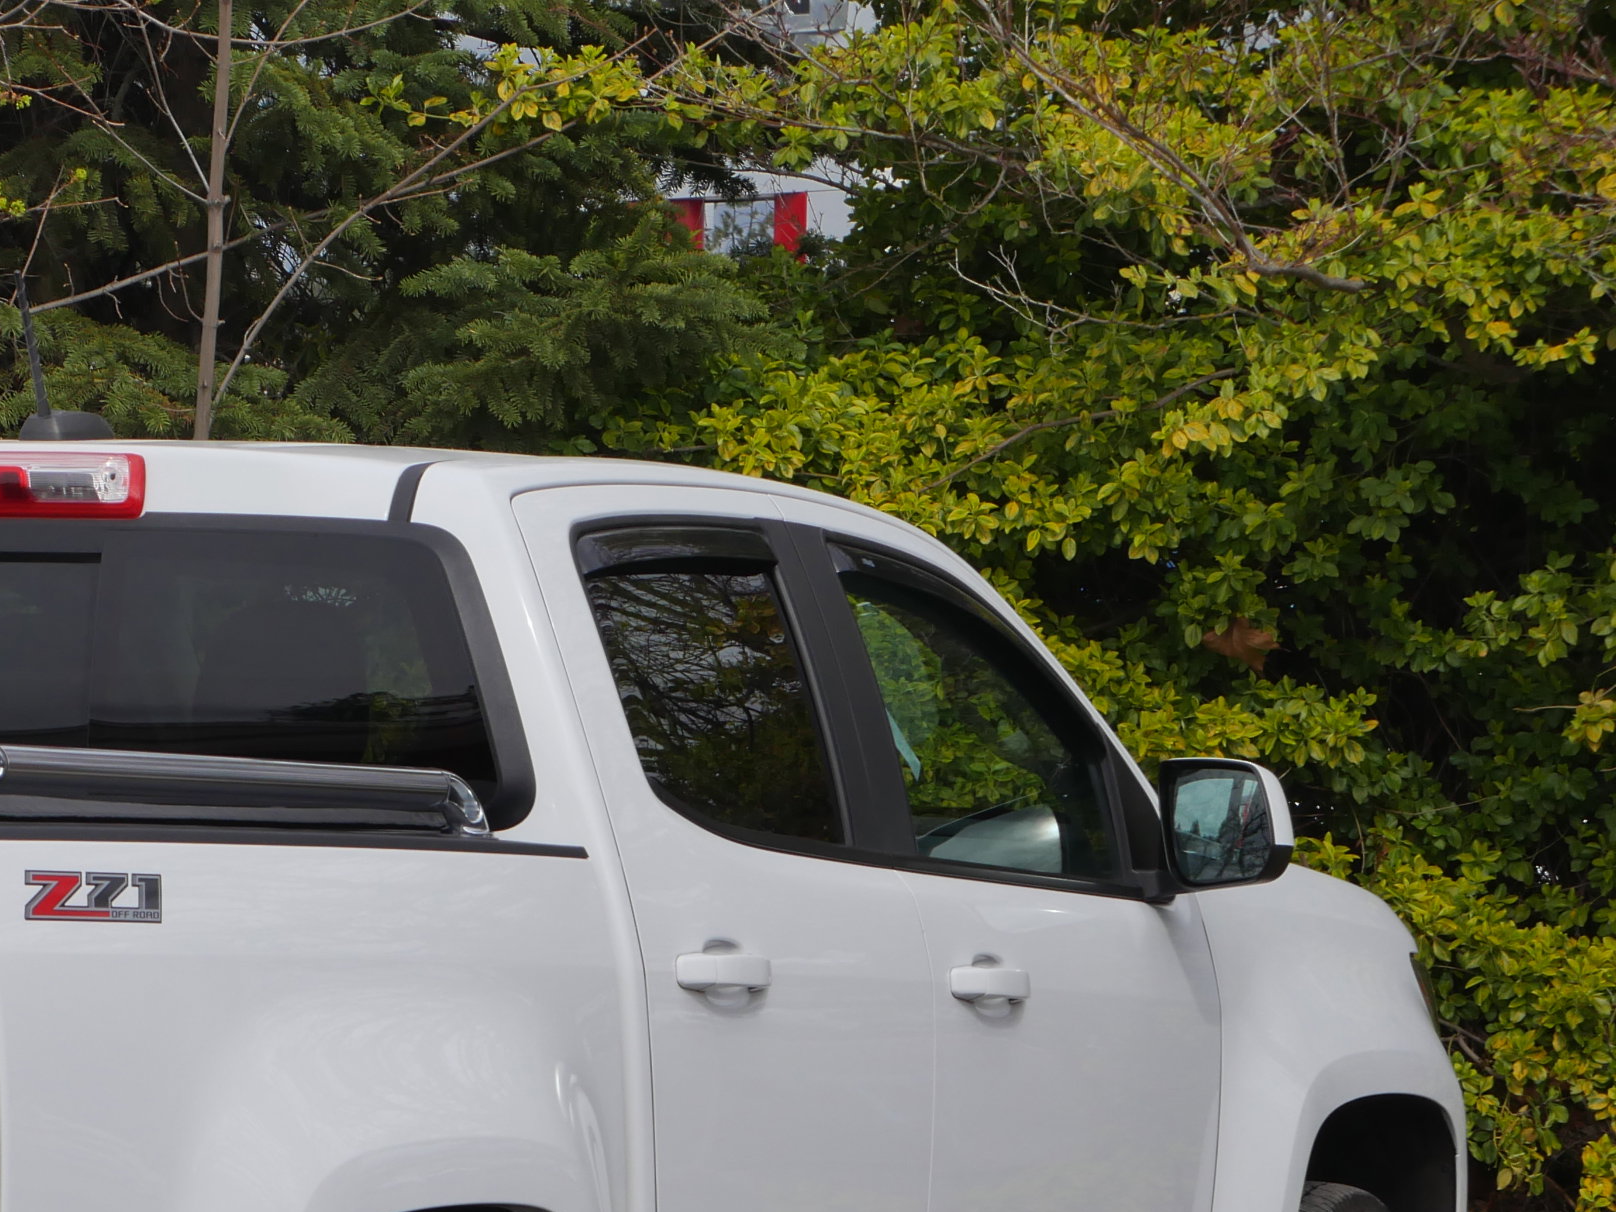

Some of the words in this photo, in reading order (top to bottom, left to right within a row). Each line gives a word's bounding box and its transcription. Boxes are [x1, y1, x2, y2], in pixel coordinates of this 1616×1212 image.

[25, 870, 161, 923] Z71
[111, 911, 129, 919] OFF
[133, 911, 160, 919] ROAD
